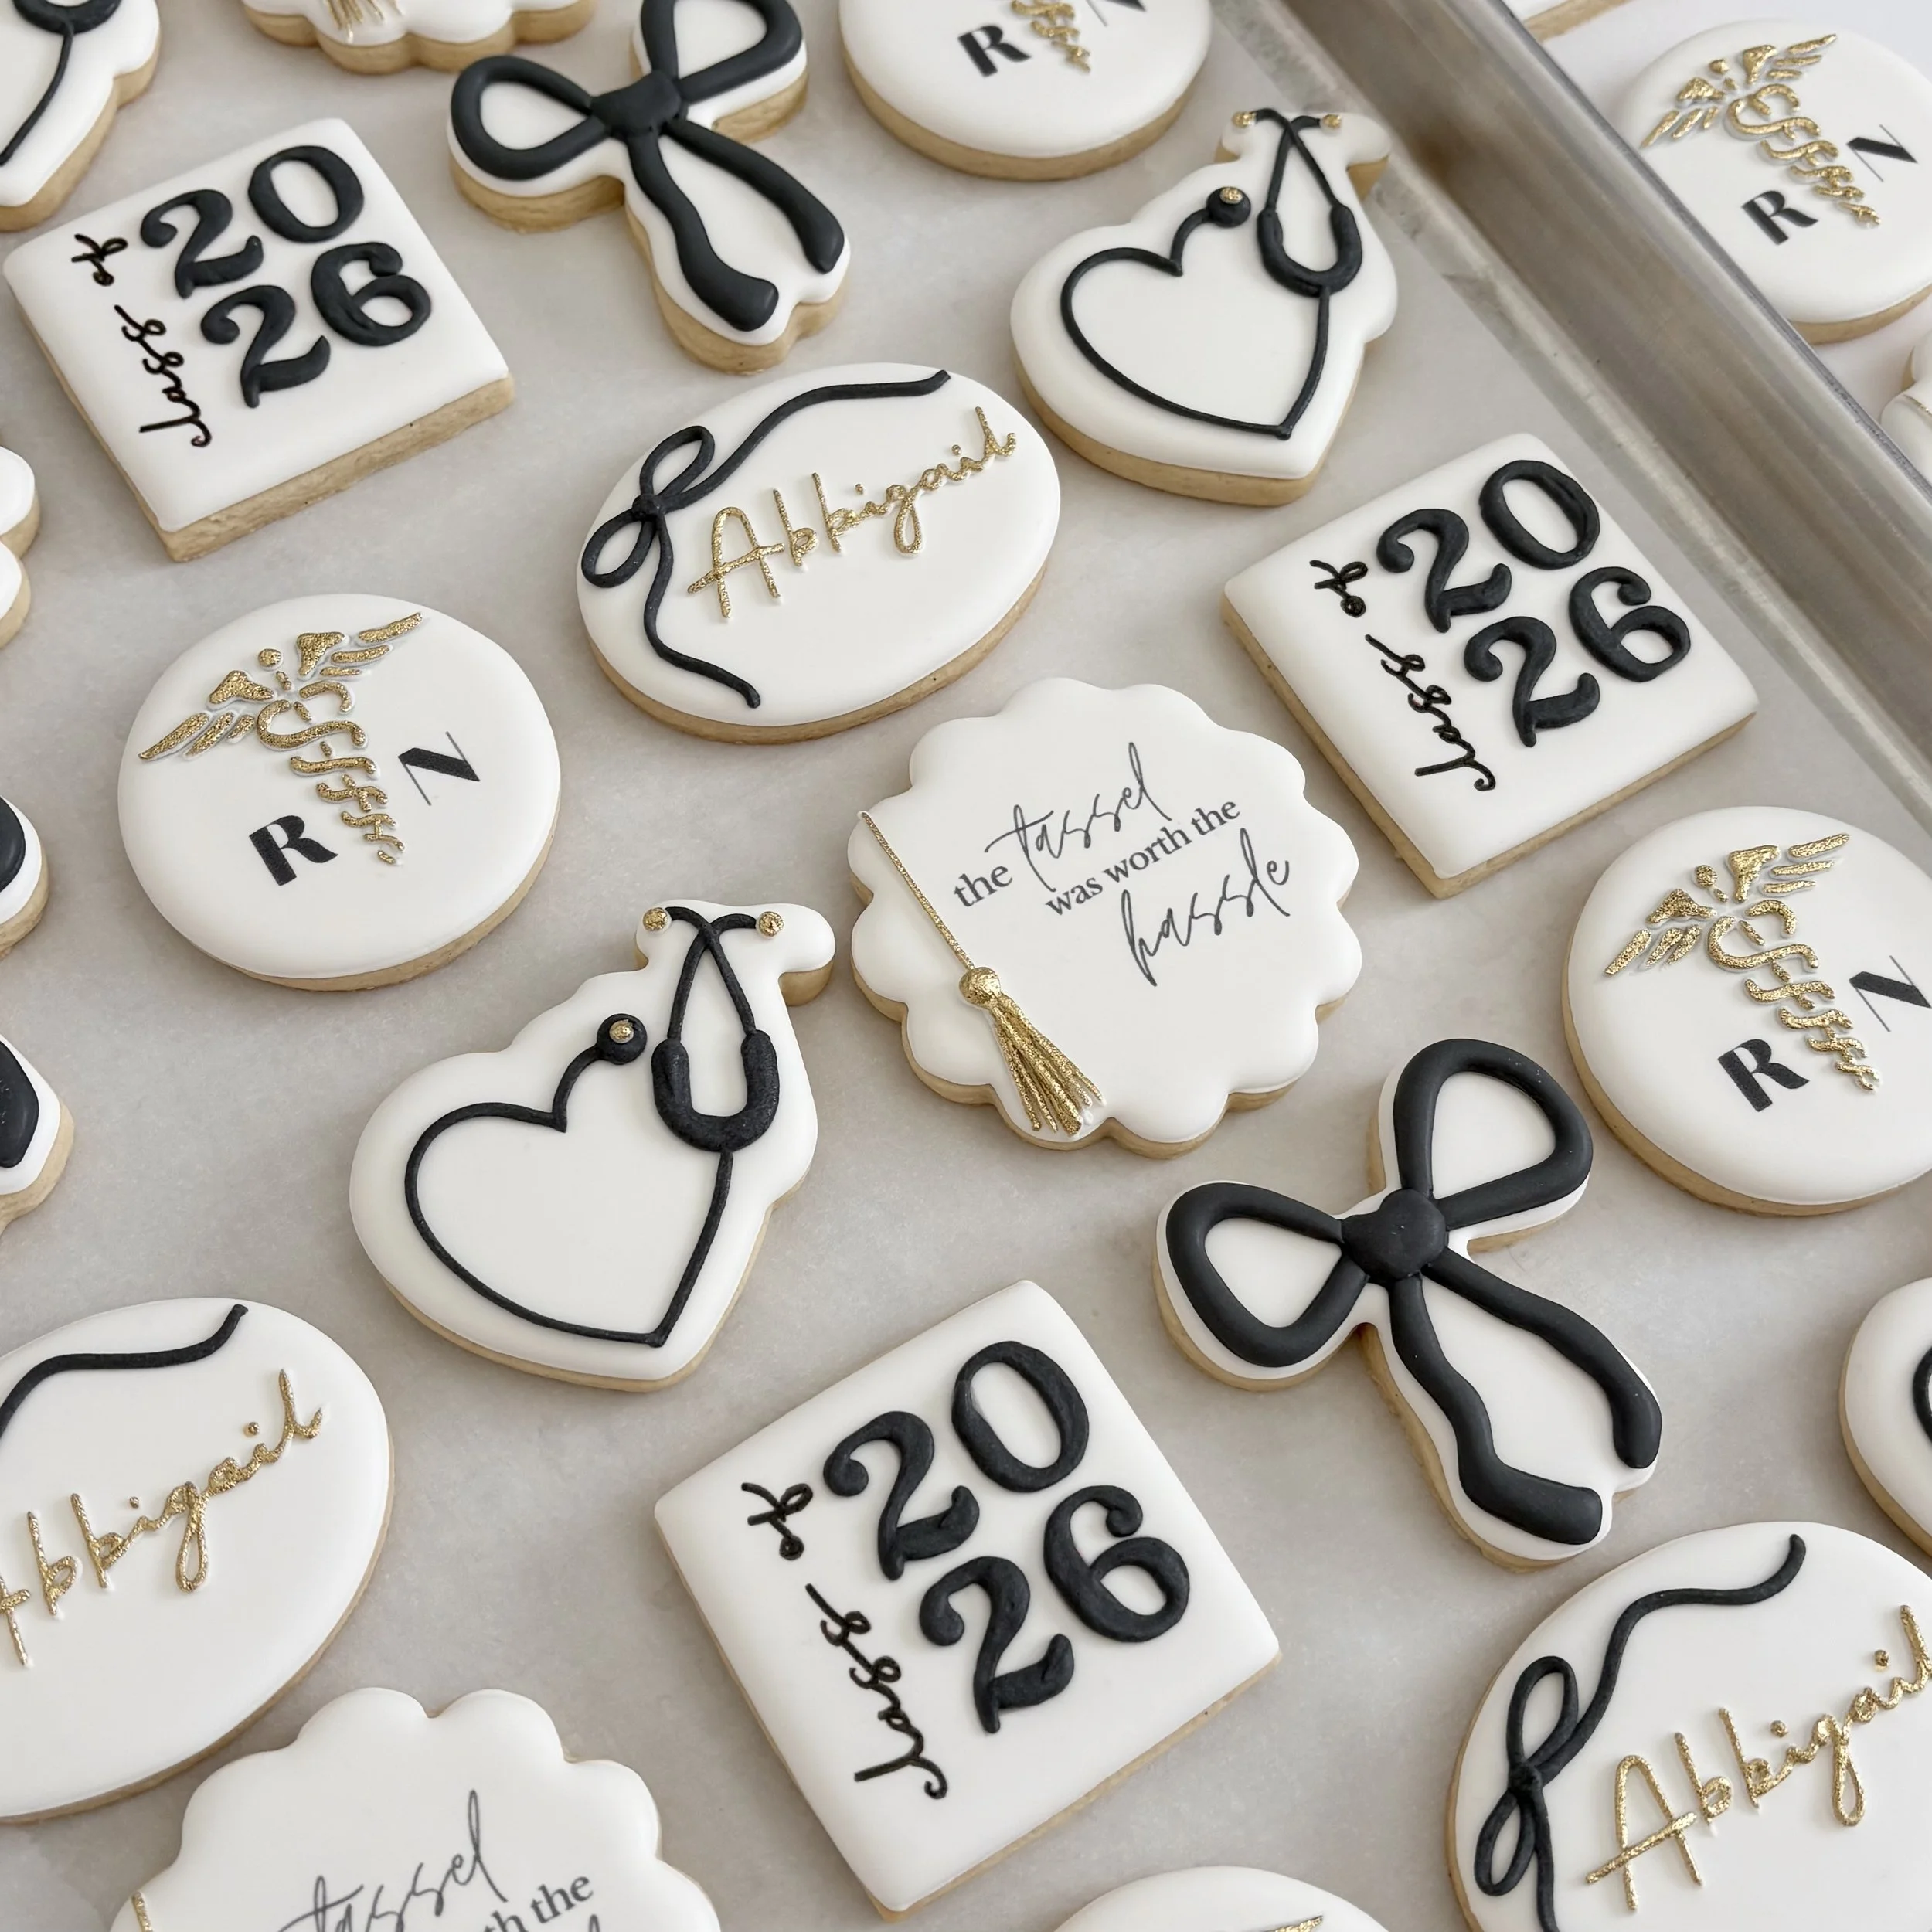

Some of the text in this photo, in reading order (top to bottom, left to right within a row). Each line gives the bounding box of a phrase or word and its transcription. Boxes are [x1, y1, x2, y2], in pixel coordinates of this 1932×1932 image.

[71, 233, 128, 287] of
[140, 145, 365, 299] 20
[199, 242, 432, 409] 26
[687, 406, 1017, 618] Abbigail
[1309, 559, 1369, 617] of
[1376, 459, 1601, 634] 20
[1463, 566, 1692, 748] 26
[953, 742, 1172, 908] the tassel
[1045, 801, 1241, 917] was worth the
[1121, 828, 1291, 987] hassle
[740, 1481, 814, 1561] of
[822, 1340, 1090, 1581] 20
[919, 1485, 1191, 1735] 26
[532, 1876, 593, 1924] the
